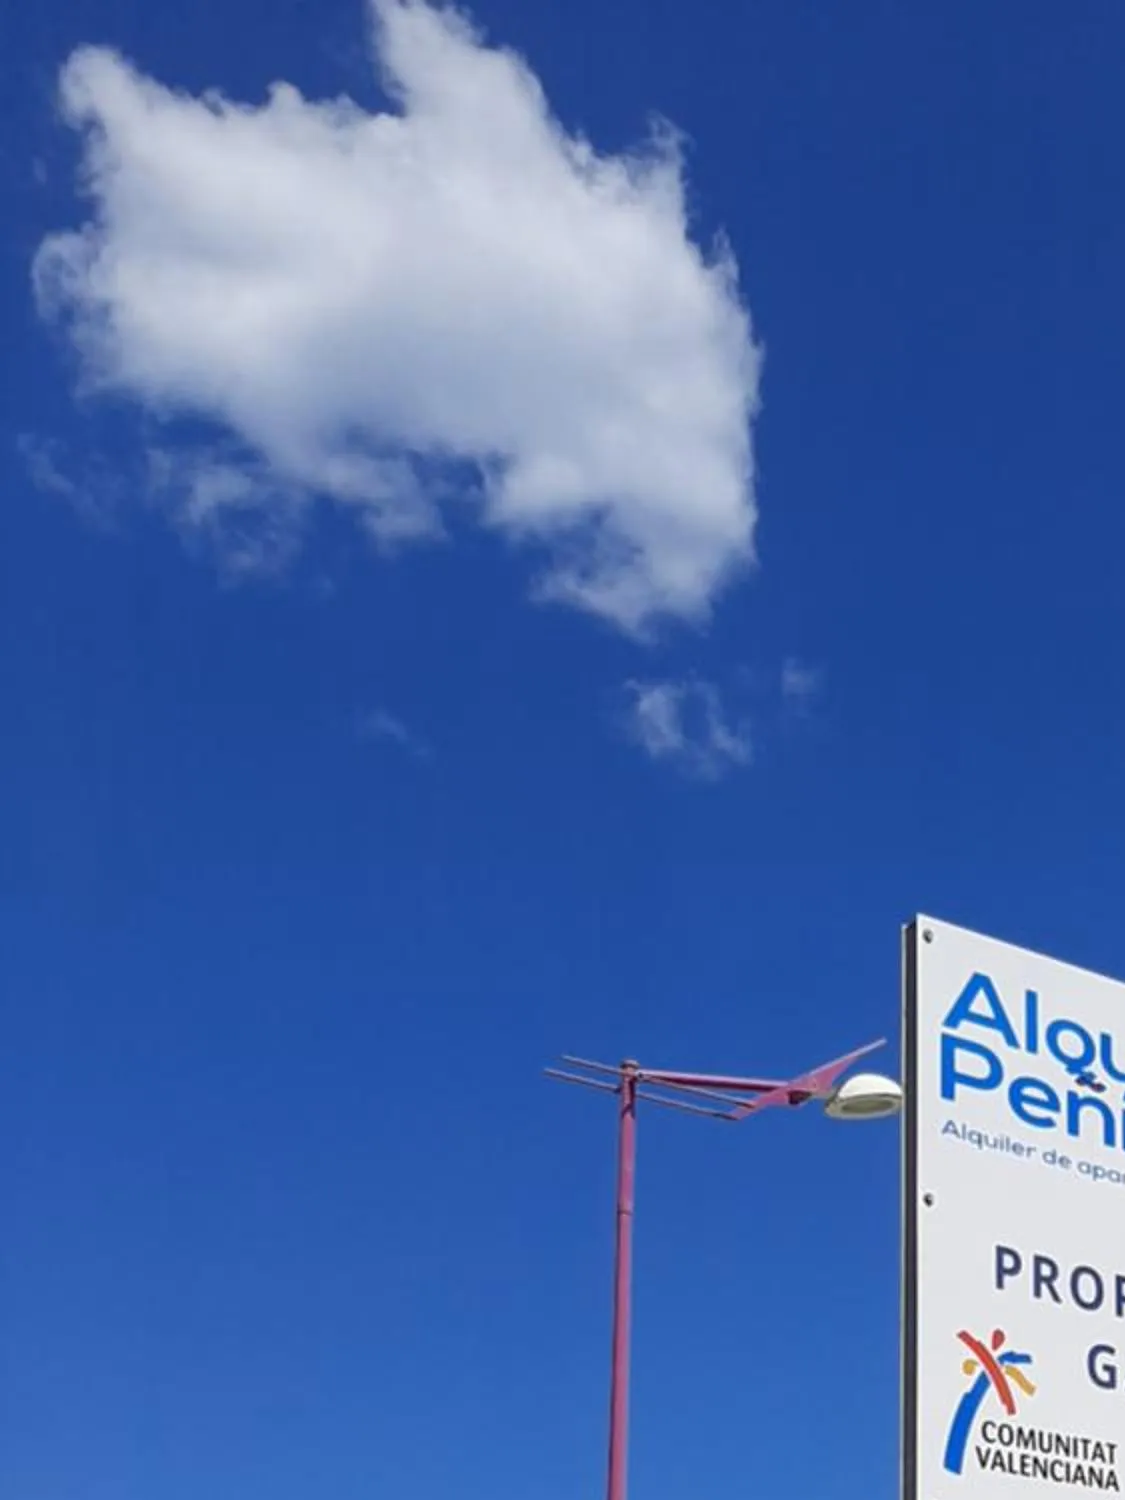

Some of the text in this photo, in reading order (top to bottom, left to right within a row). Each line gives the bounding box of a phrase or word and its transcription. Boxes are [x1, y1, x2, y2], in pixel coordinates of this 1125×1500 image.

[941, 1119, 1037, 1157] Alquiler
[1042, 1150, 1073, 1169] de
[981, 1420, 1118, 1465] COMUNITAT
[975, 1445, 1120, 1493] VALENCIANA
